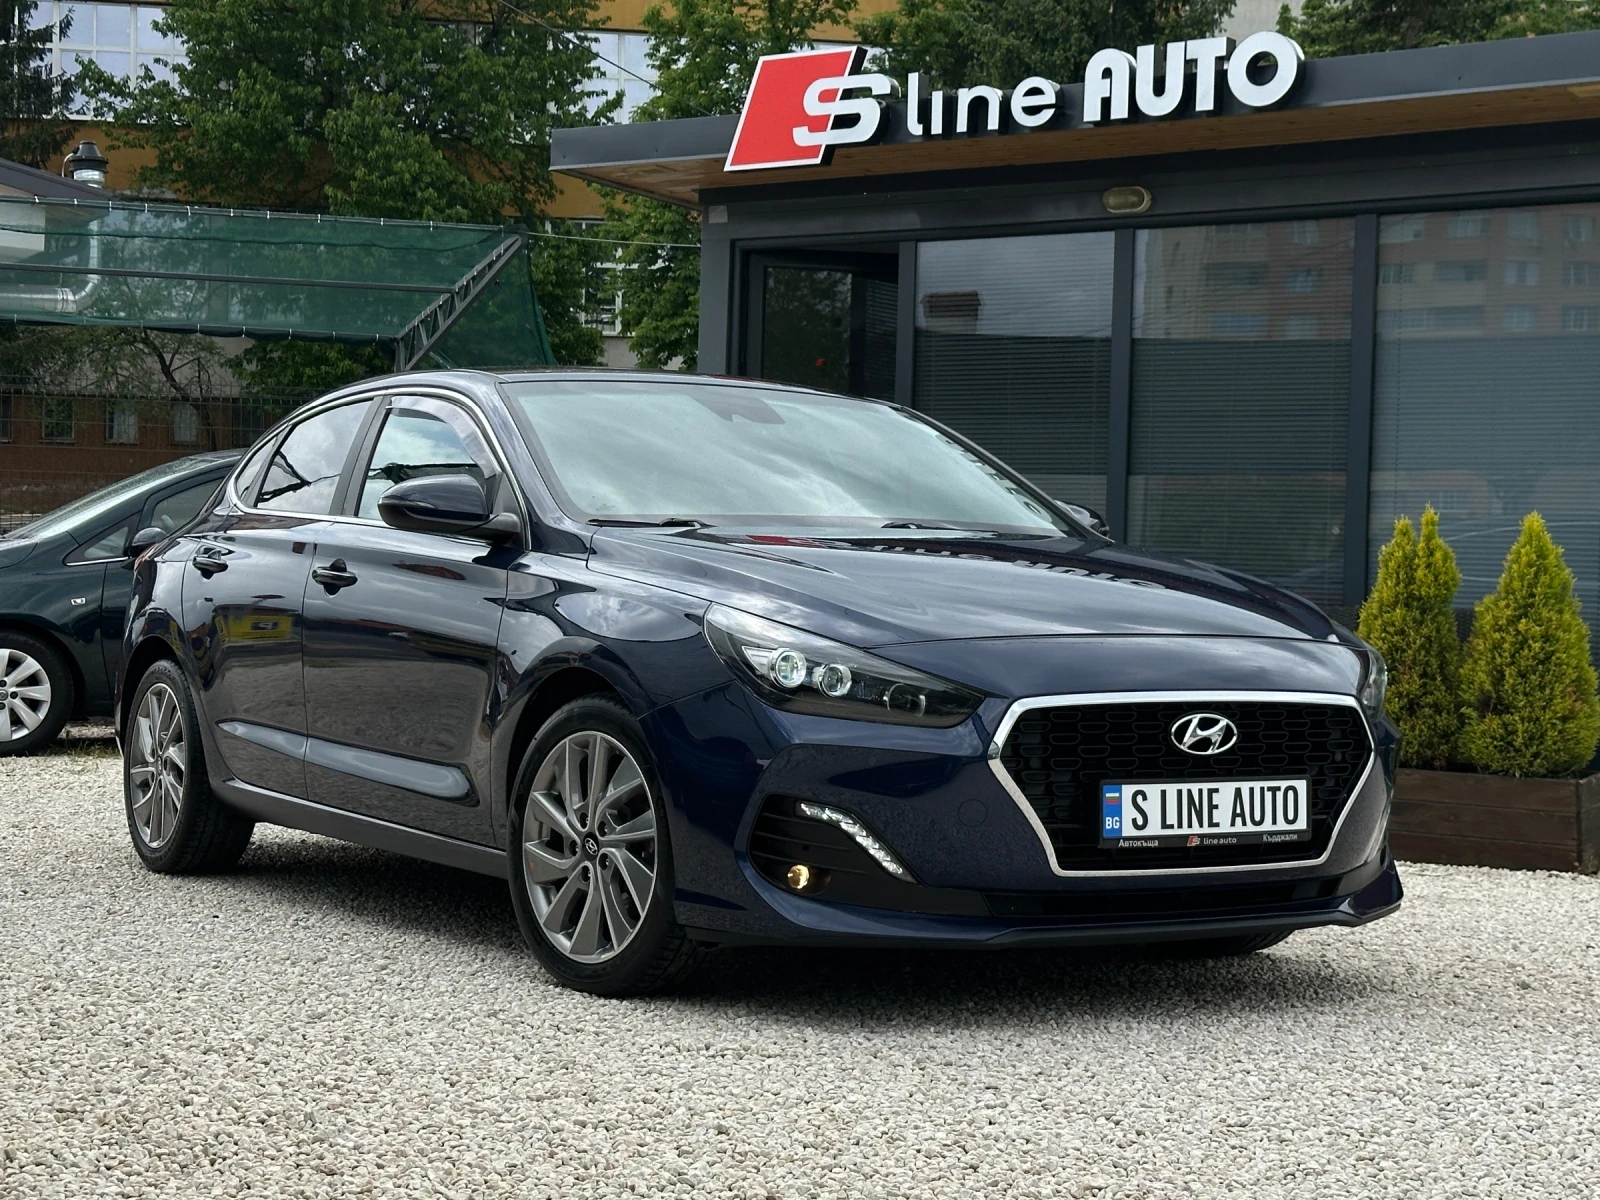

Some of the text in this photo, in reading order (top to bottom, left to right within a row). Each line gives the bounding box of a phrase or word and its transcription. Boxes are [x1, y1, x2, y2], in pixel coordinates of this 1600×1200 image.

[792, 31, 1301, 146] S line AUTO
[1131, 785, 1299, 831] S LINE AUTO
[1105, 816, 1120, 829] BG
[1118, 838, 1159, 848] Автокъща
[1219, 836, 1237, 845] auto
[1262, 832, 1298, 843] Кърджали
